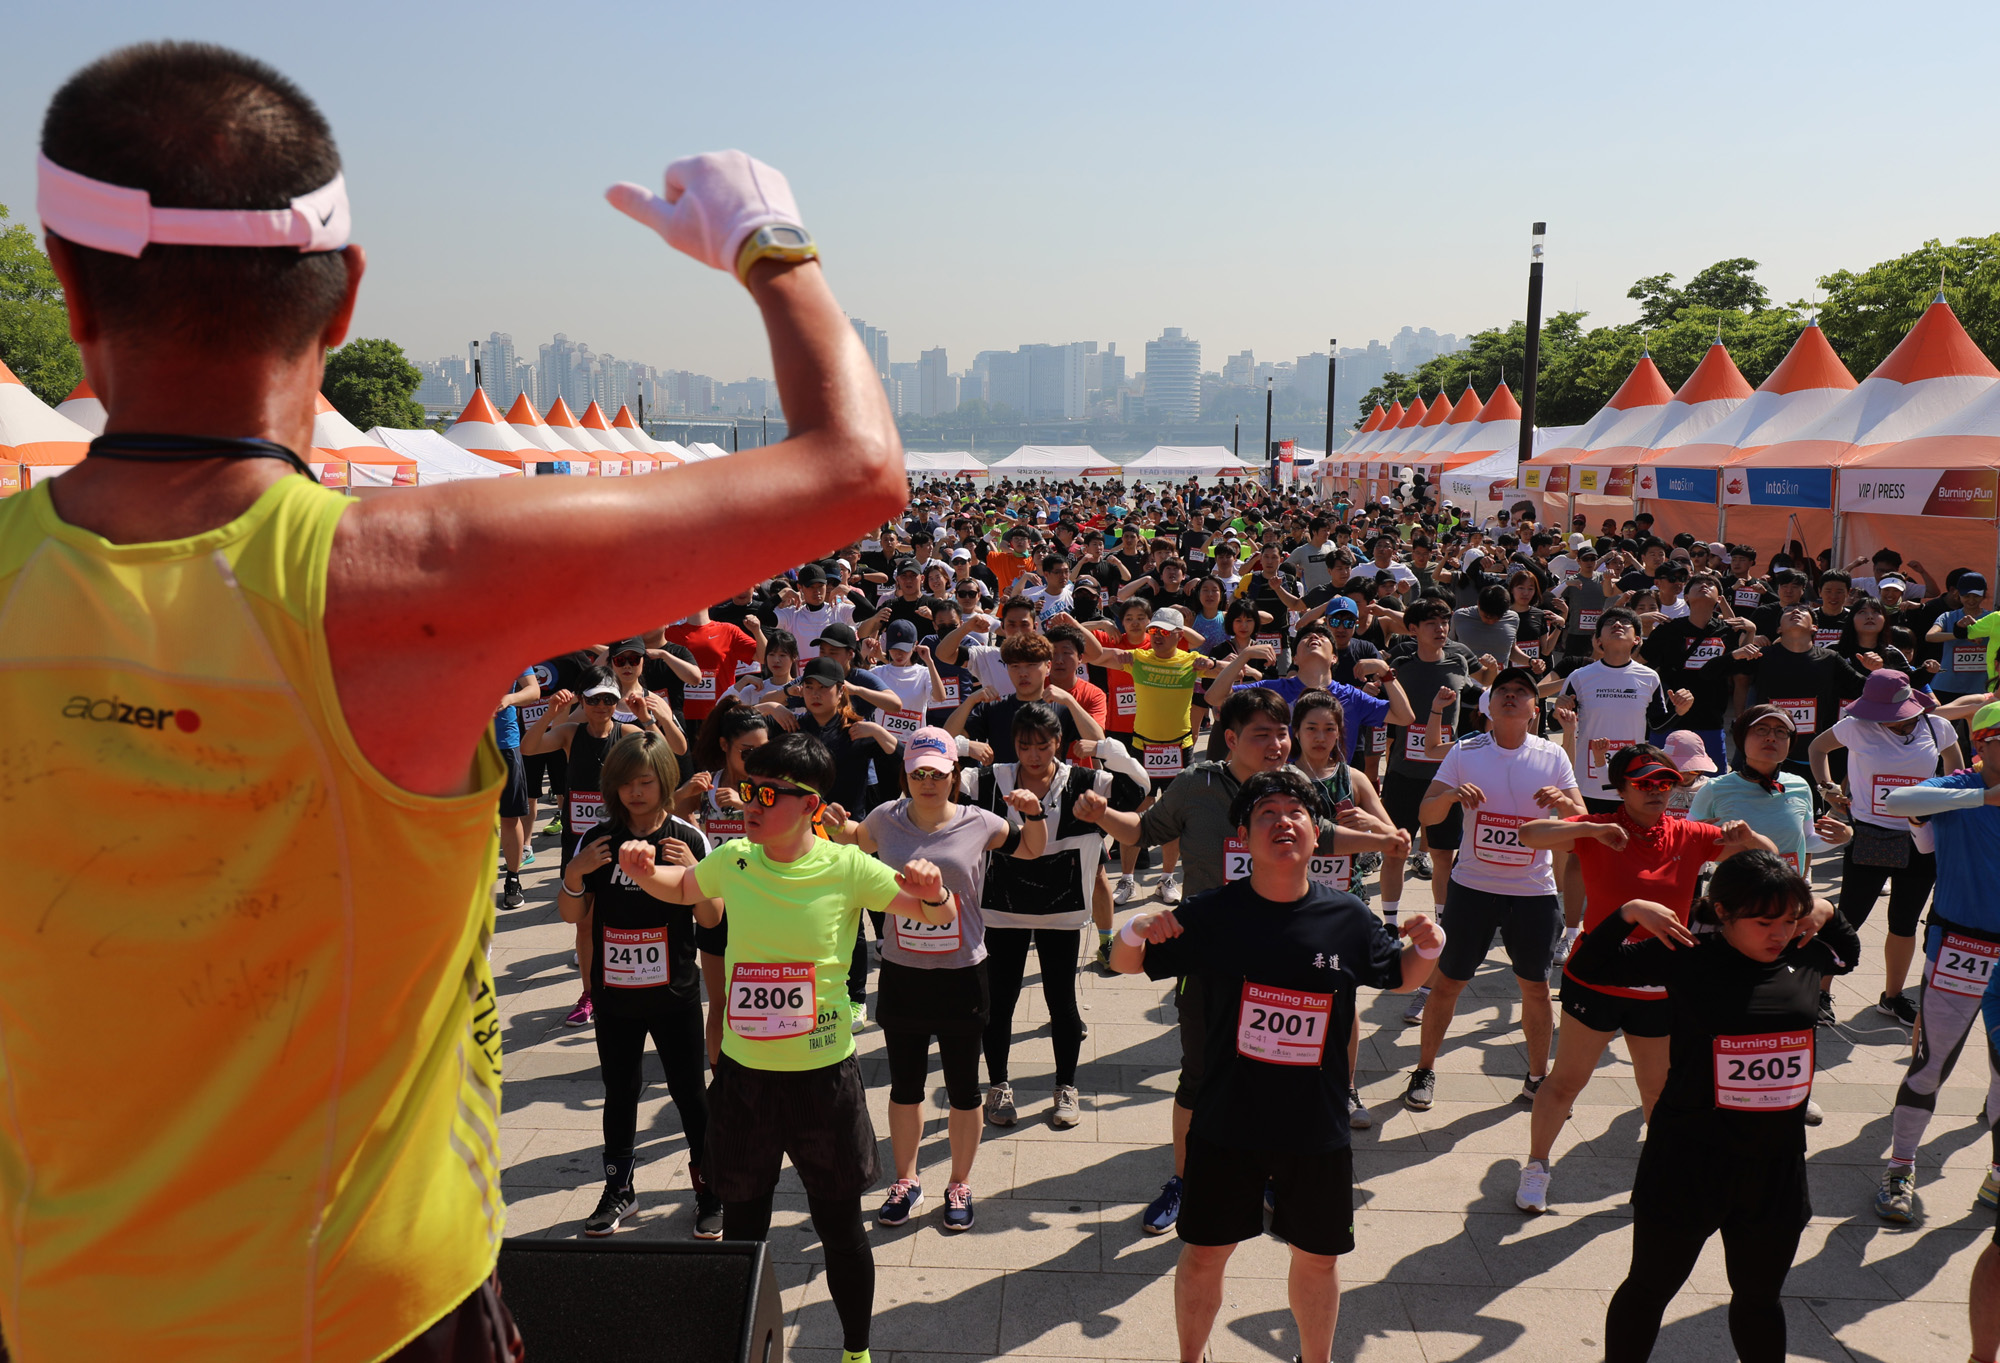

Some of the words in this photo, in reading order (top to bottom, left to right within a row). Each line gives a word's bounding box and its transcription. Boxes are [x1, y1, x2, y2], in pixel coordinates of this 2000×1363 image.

[2, 477, 18, 487] Run
[1858, 483, 1871, 498] VIP
[1878, 483, 1905, 499] PRESS
[1938, 487, 1974, 501] Burning
[1973, 487, 1993, 498] Run
[1738, 592, 1760, 600] 2017
[1957, 653, 1985, 662] 2075
[886, 716, 917, 732] 2896
[1148, 754, 1179, 765] 2024
[1877, 777, 1910, 786] Burning
[572, 793, 602, 801] Burning
[709, 822, 743, 831] Burning
[1481, 815, 1516, 827] Burning
[1309, 859, 1345, 874] 057
[605, 930, 641, 942] Burning
[642, 931, 663, 939] Run
[1946, 935, 1992, 955] Burning
[608, 946, 660, 965] 2410
[1312, 952, 1342, 971] 柔道
[641, 965, 662, 975] A-40
[1944, 952, 1990, 977] 241
[736, 966, 780, 979] Burning
[782, 966, 809, 976] Run
[737, 986, 804, 1010] 2806
[1248, 985, 1302, 1007] Burning
[1302, 995, 1328, 1007] Run
[778, 1020, 798, 1029] A-4
[818, 1010, 838, 1025] 014
[1249, 1008, 1316, 1038] 2001
[1243, 1030, 1267, 1044] B-41
[1720, 1038, 1778, 1051] Burning
[1779, 1036, 1807, 1047] Run
[1727, 1055, 1802, 1081] 2605
